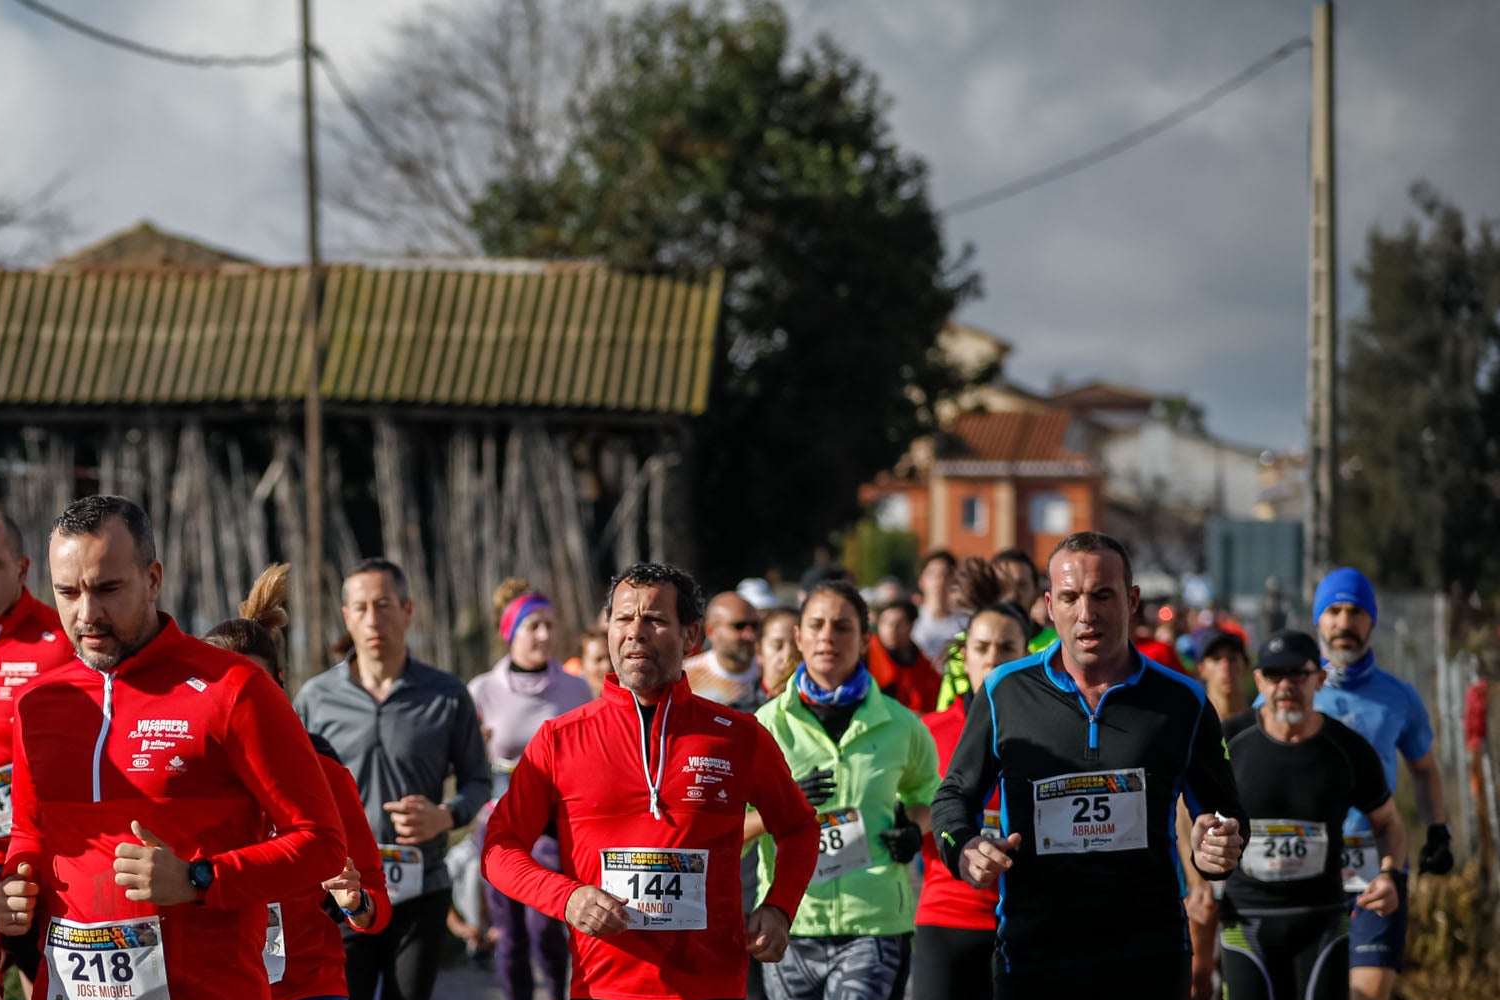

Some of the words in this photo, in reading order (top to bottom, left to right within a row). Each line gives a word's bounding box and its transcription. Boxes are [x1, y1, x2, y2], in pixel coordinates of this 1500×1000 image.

[138, 720, 149, 732] VII
[1072, 796, 1111, 823] 25
[1072, 824, 1115, 836] ABRAHAM
[1264, 838, 1307, 858] 246
[628, 873, 682, 900] 144
[637, 902, 672, 914] MANOLO
[70, 928, 110, 936] CARRERA
[68, 952, 133, 982] 218
[77, 984, 98, 997] JOSE
[100, 984, 135, 998] MIGUEL
